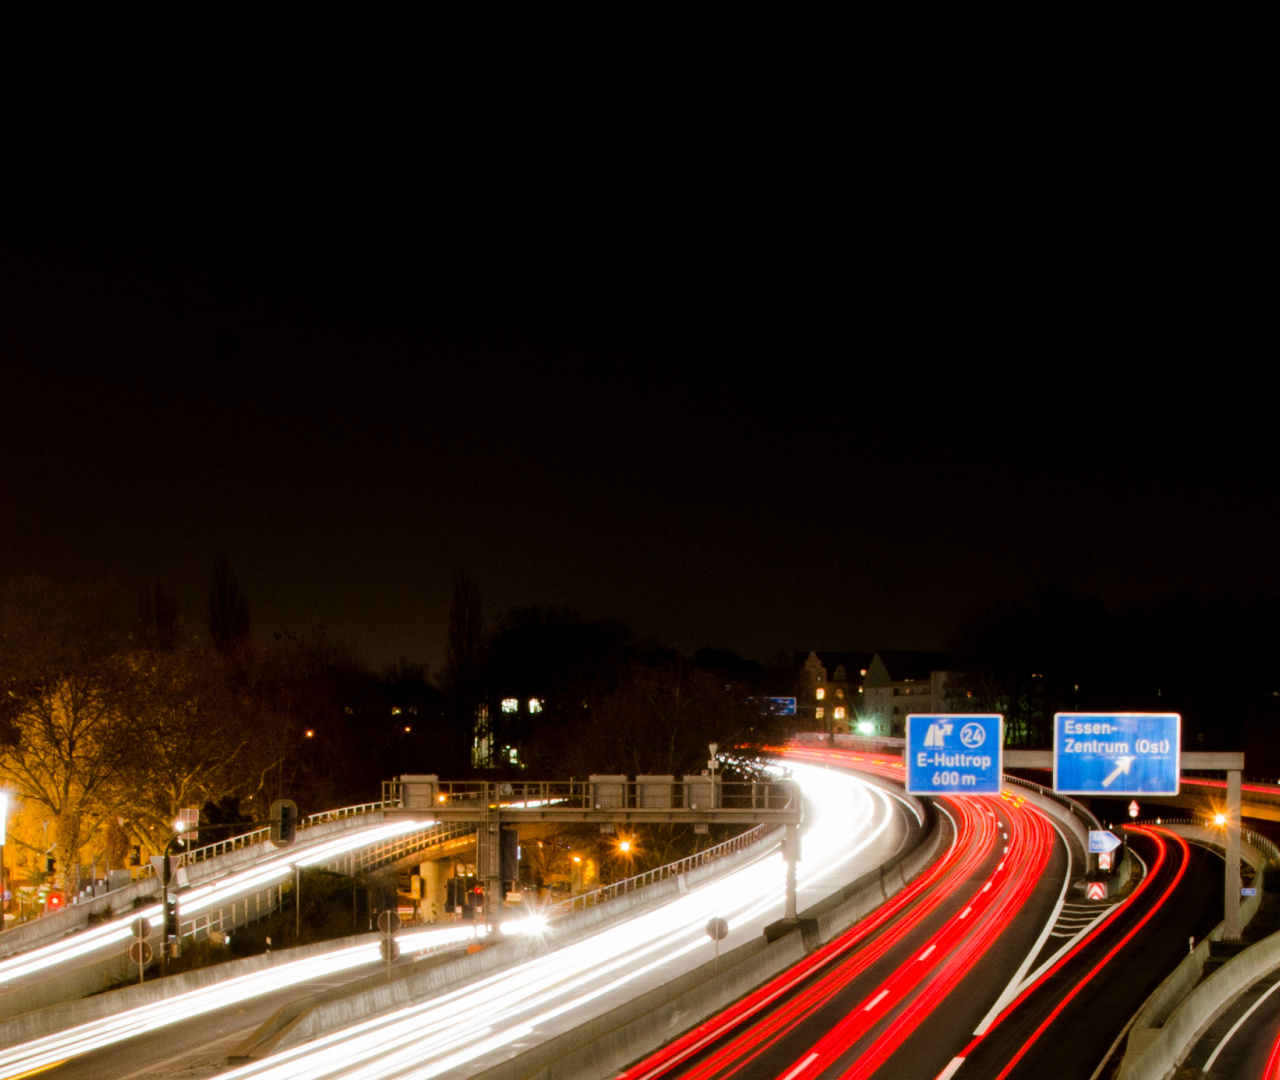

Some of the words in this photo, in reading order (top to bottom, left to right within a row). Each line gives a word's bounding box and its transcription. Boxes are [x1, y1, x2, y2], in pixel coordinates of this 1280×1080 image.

[964, 728, 981, 742] 24
[1064, 720, 1118, 735] Essen-
[1064, 739, 1129, 753] Zentrum
[1135, 738, 1170, 754] (Ost)
[917, 753, 991, 770] E-Huttrop
[932, 771, 959, 785] 600
[961, 774, 976, 785] m
